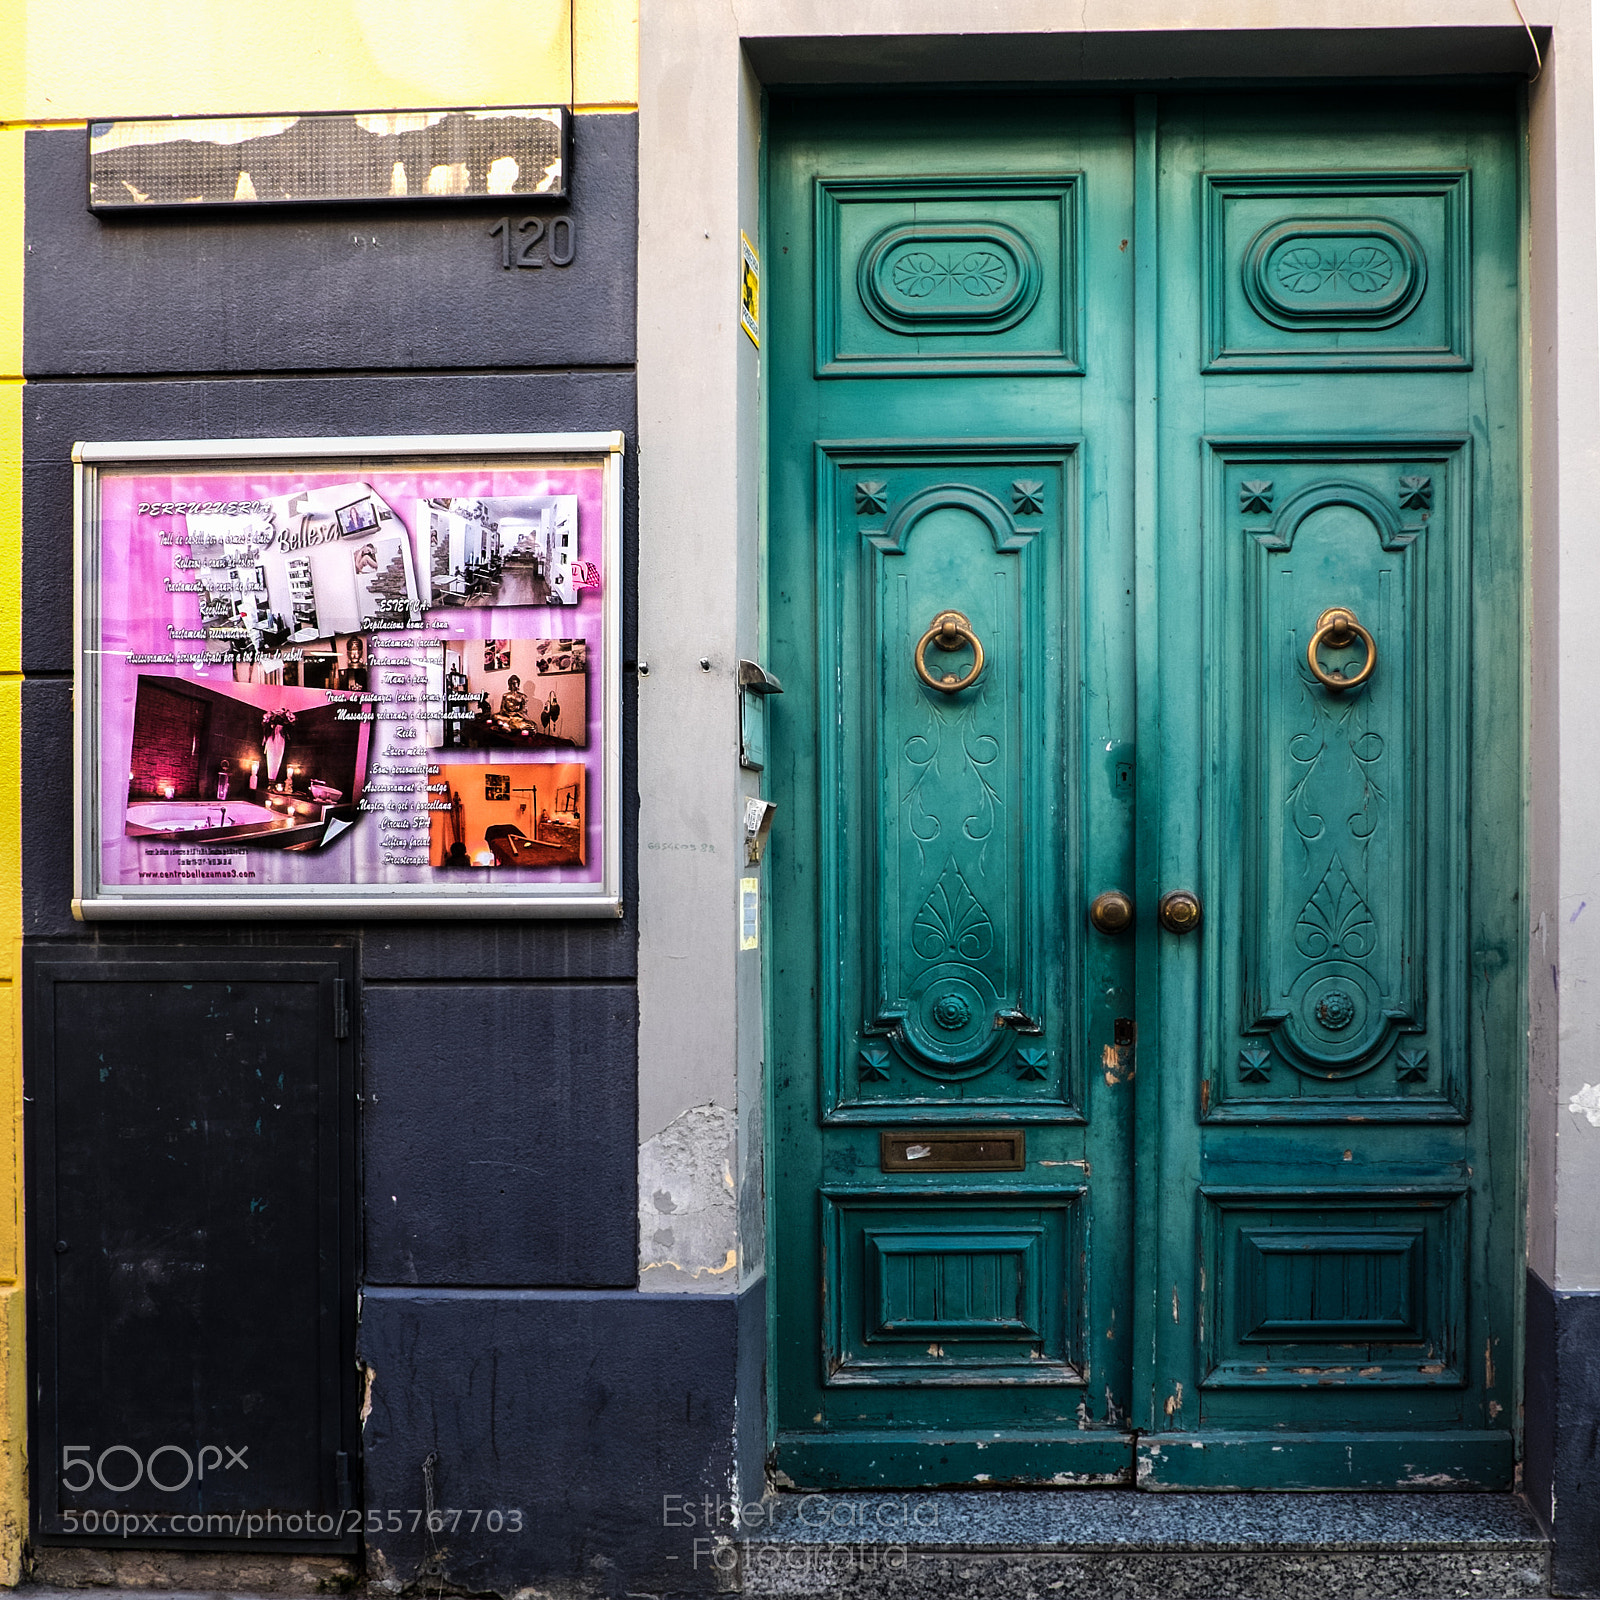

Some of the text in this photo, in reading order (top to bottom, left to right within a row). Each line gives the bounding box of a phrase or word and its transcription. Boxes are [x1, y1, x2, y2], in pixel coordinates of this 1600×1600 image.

[487, 215, 576, 270] 120
[277, 512, 341, 554] Bellesa
[406, 617, 424, 630] home
[431, 619, 449, 630] dona
[349, 692, 358, 703] de
[411, 816, 431, 829] SPA
